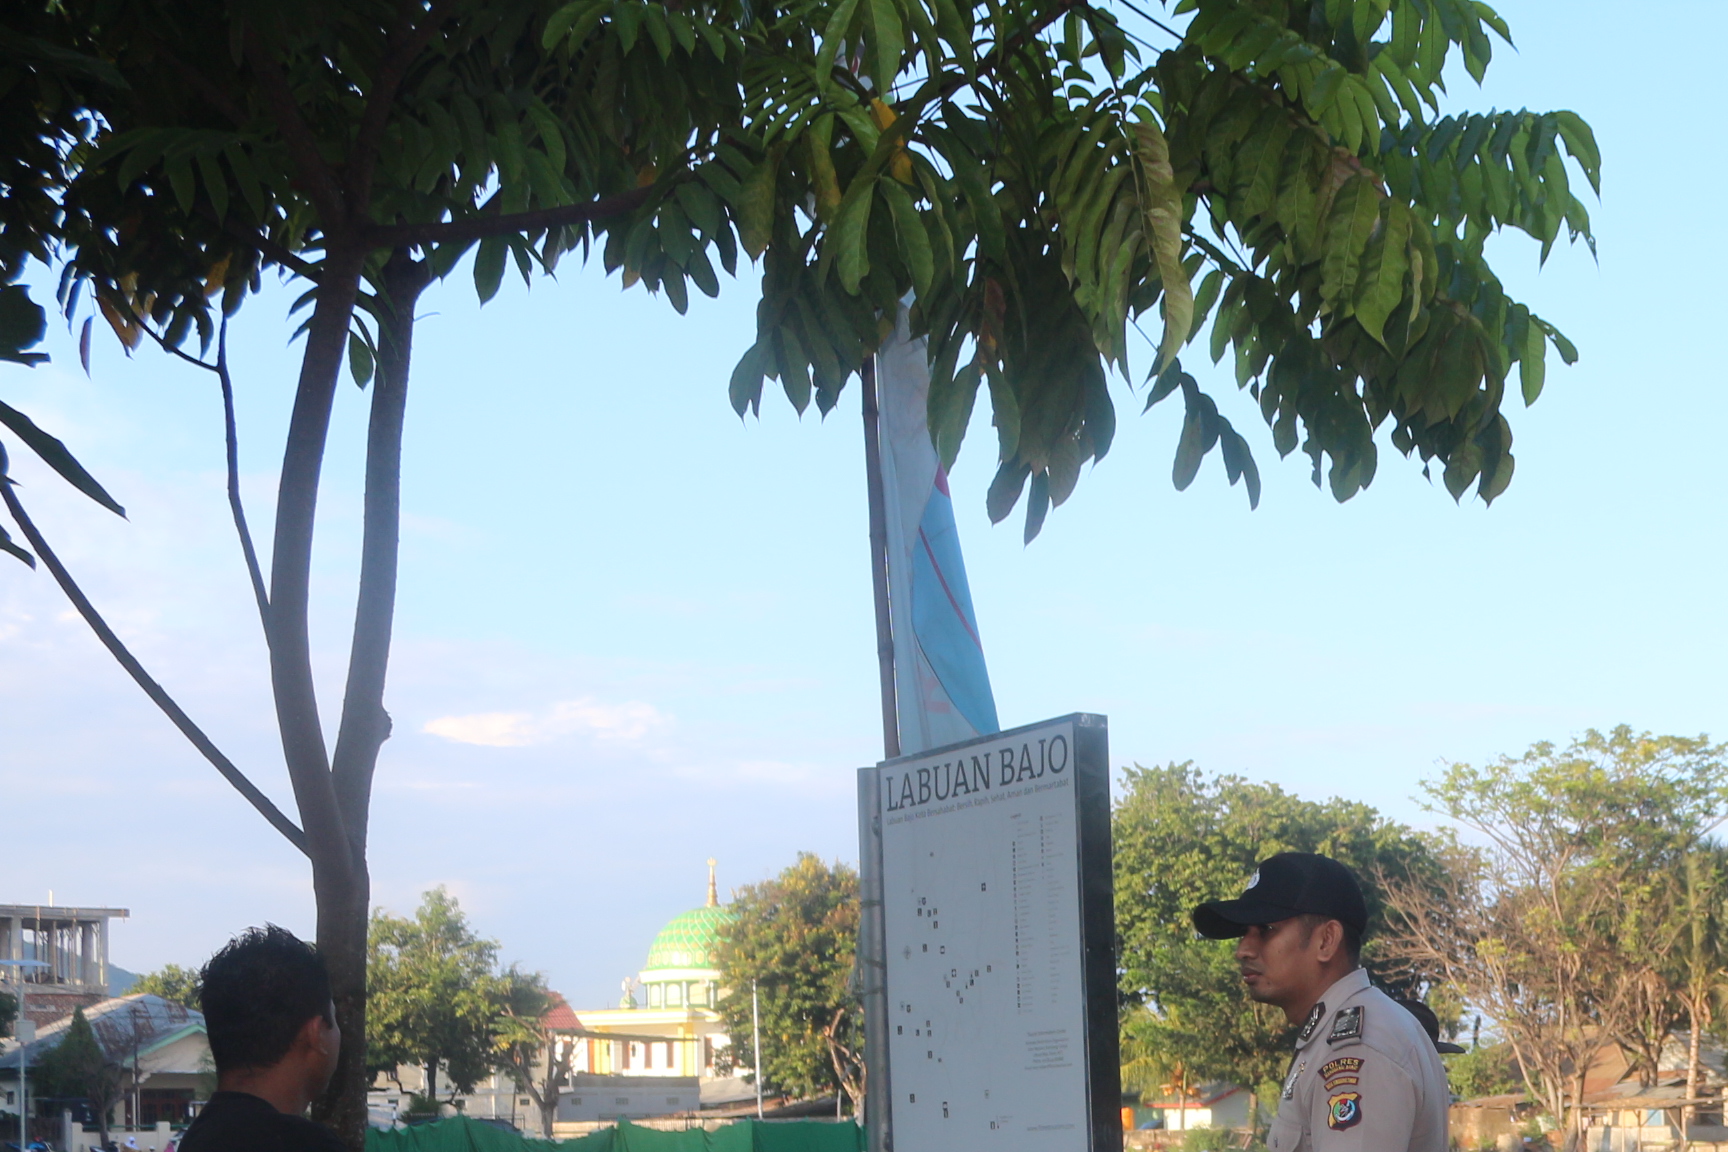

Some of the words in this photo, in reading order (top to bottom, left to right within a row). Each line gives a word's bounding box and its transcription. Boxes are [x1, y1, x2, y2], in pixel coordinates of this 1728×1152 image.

[886, 752, 991, 812] LABUAN
[999, 734, 1068, 787] BAJO
[1322, 1058, 1359, 1073] POLRES
